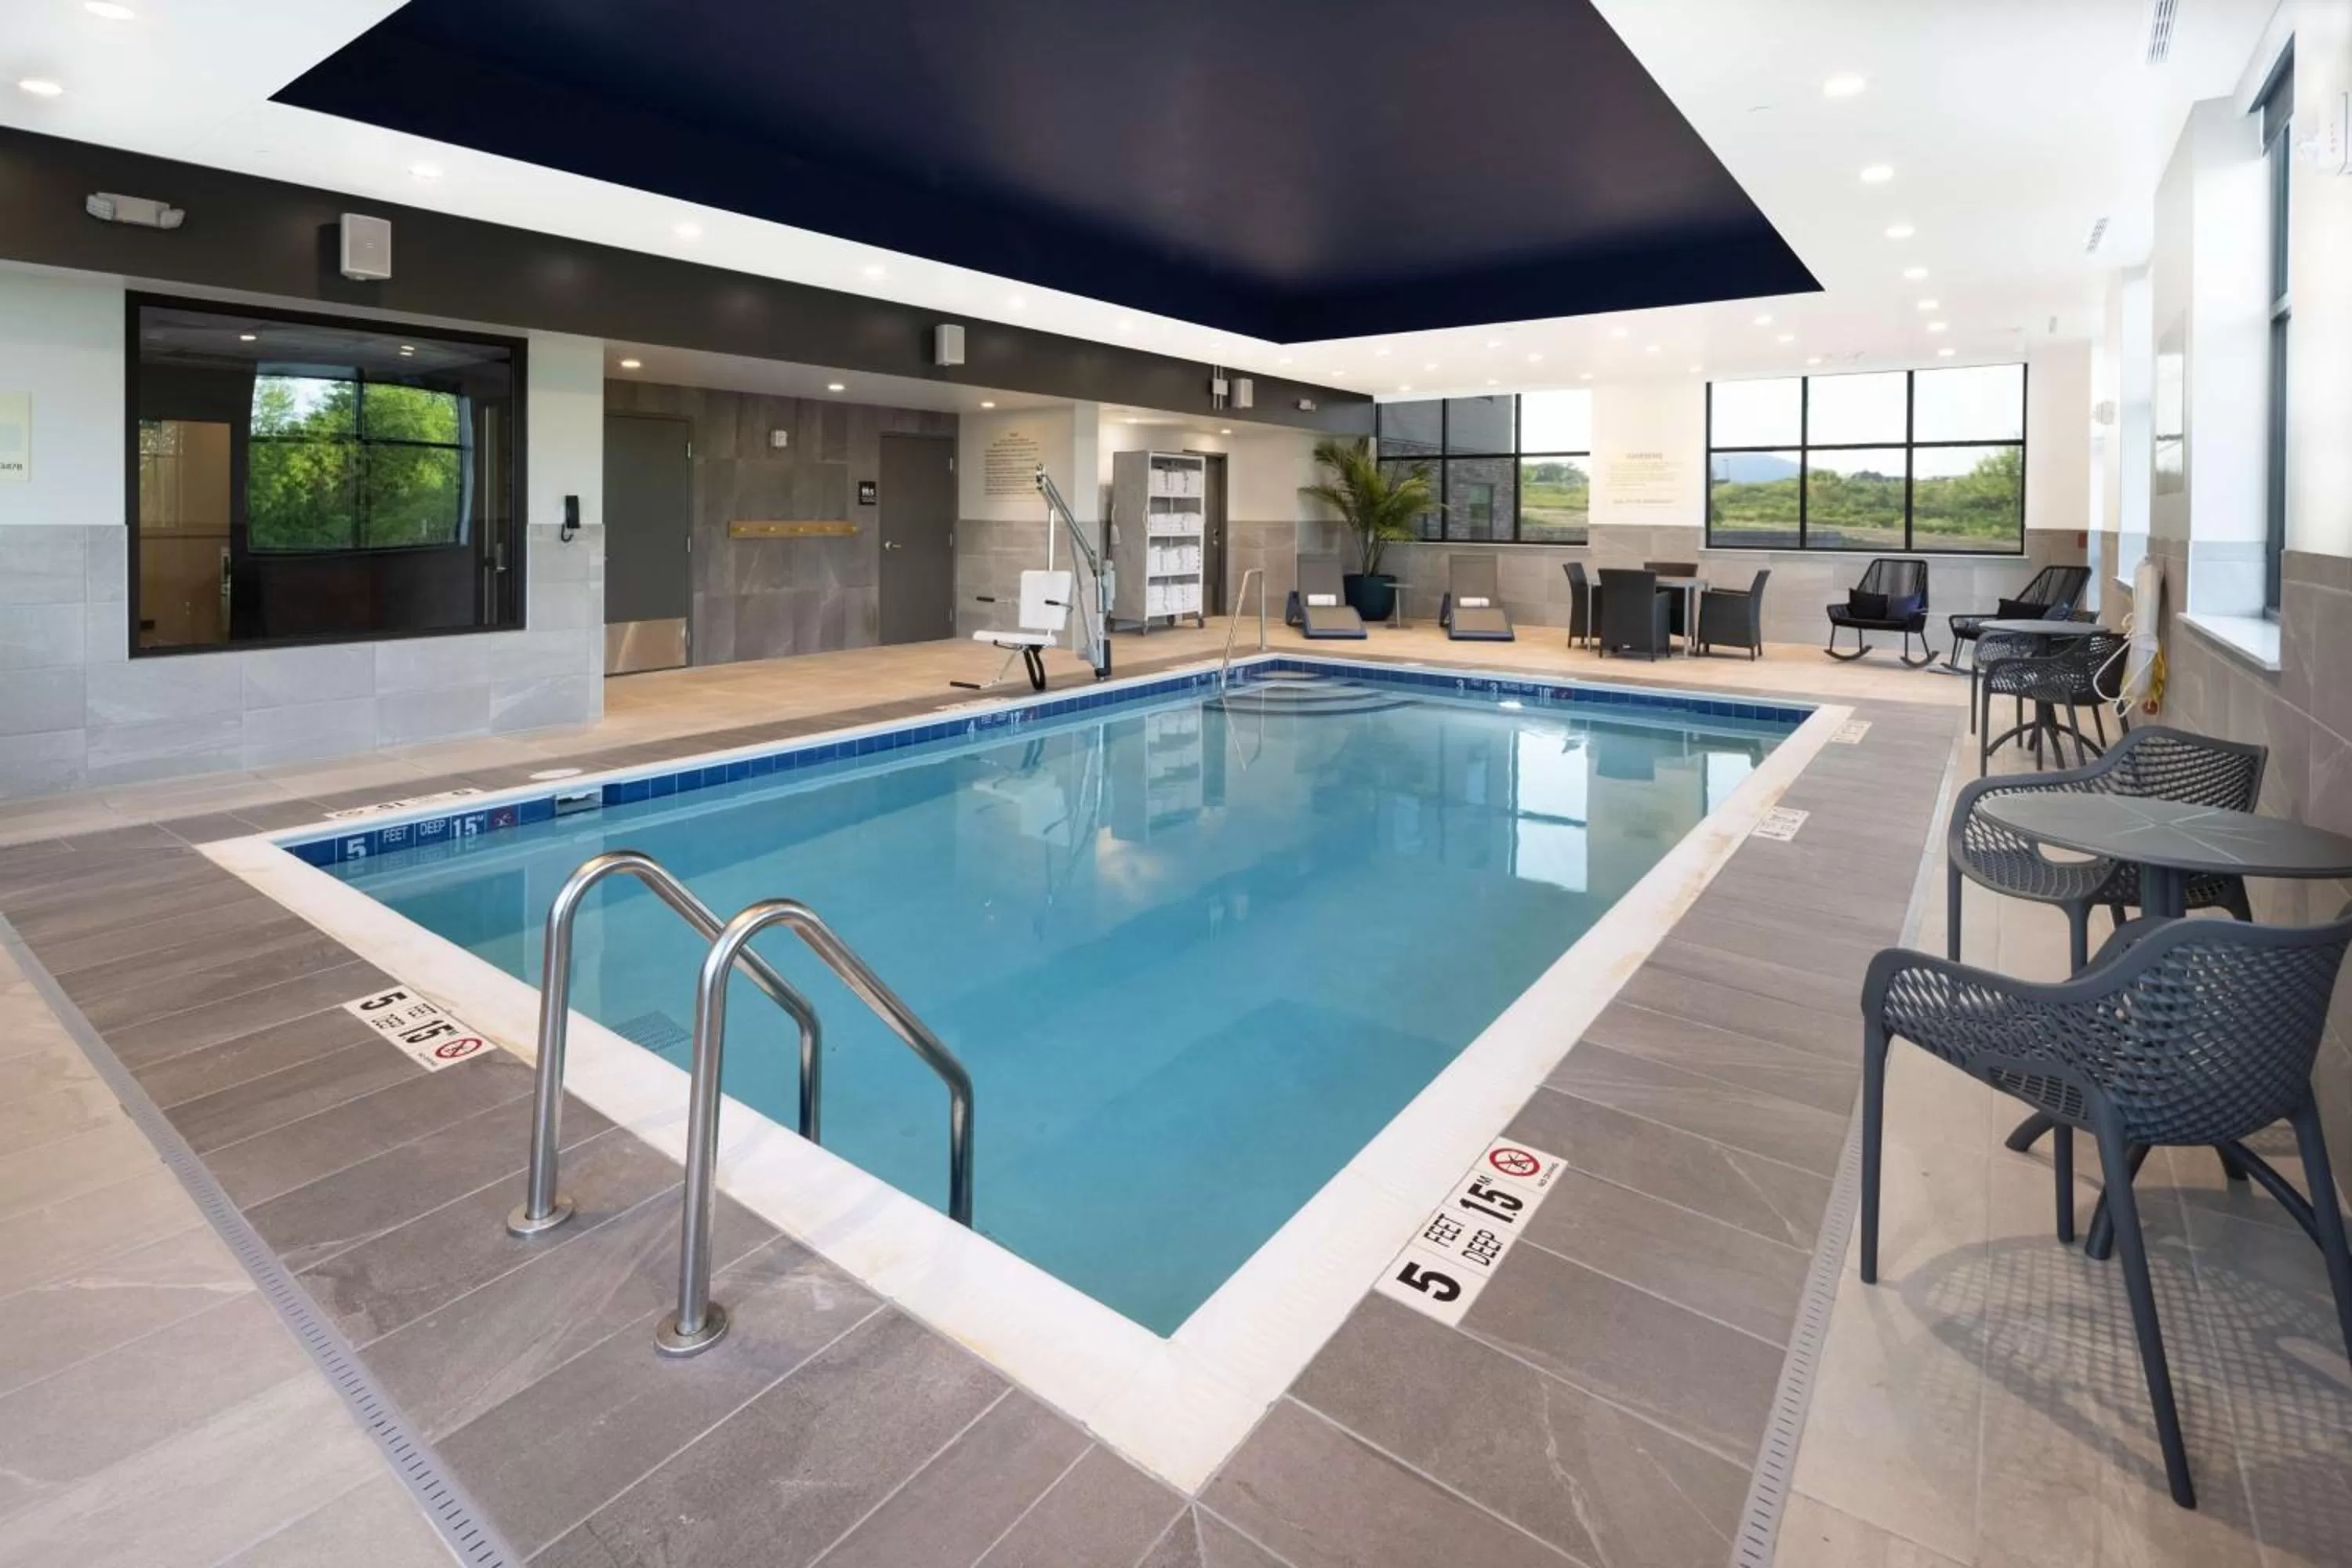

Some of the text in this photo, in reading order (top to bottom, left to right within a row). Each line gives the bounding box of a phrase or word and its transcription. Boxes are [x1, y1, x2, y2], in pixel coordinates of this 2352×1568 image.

[347, 837, 366, 859] 5
[383, 826, 408, 844] FEET
[419, 819, 446, 836] DEEP
[360, 992, 408, 1011] 5
[1423, 1213, 1465, 1248] FEET
[1461, 1229, 1504, 1267] DEEP
[1396, 1261, 1462, 1302] 5
